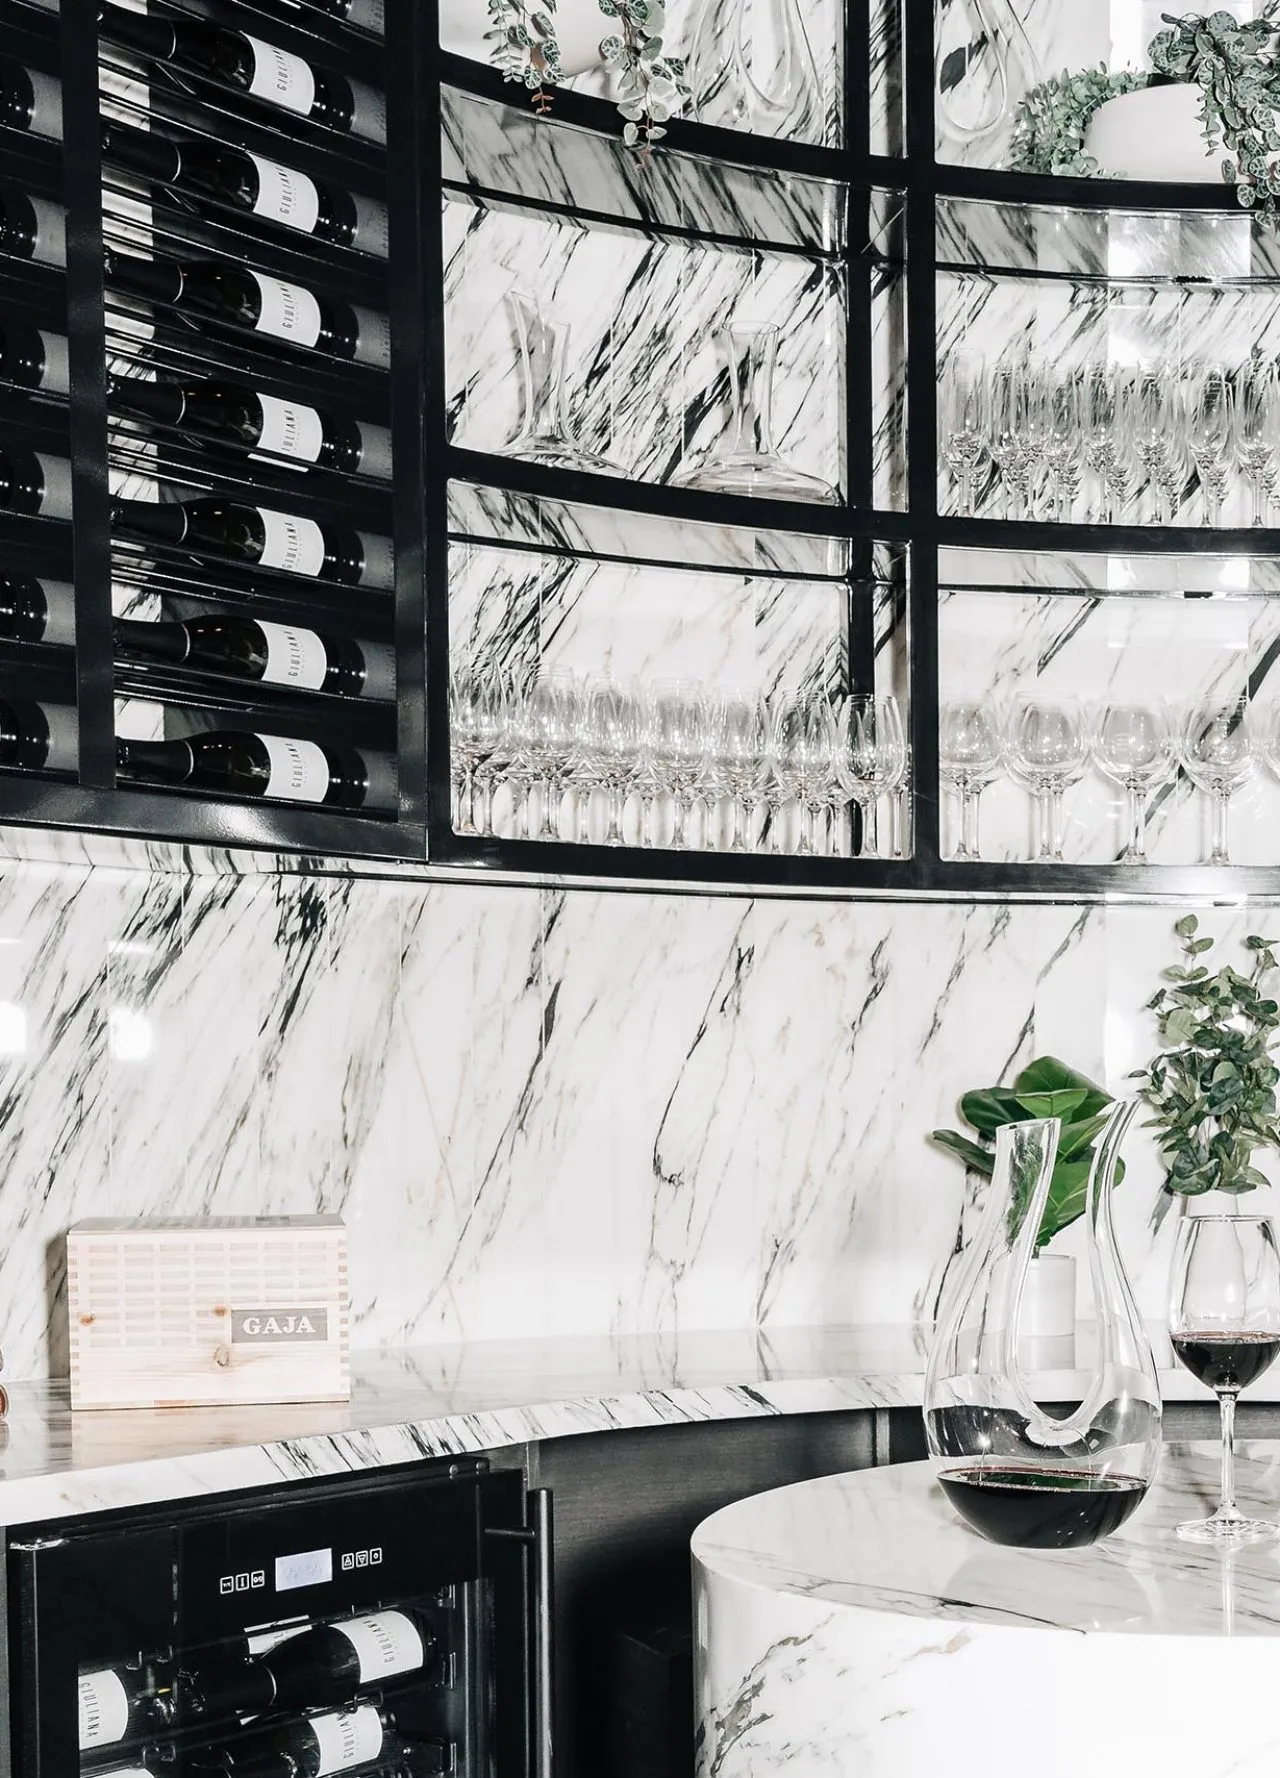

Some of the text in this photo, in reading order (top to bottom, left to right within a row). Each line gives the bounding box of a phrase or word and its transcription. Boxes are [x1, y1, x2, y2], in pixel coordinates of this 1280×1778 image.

[281, 409, 297, 452] IULIANA
[242, 1315, 316, 1336] GAJA
[79, 1682, 100, 1738] GIULIANA
[337, 1712, 354, 1759] GIULIAN
